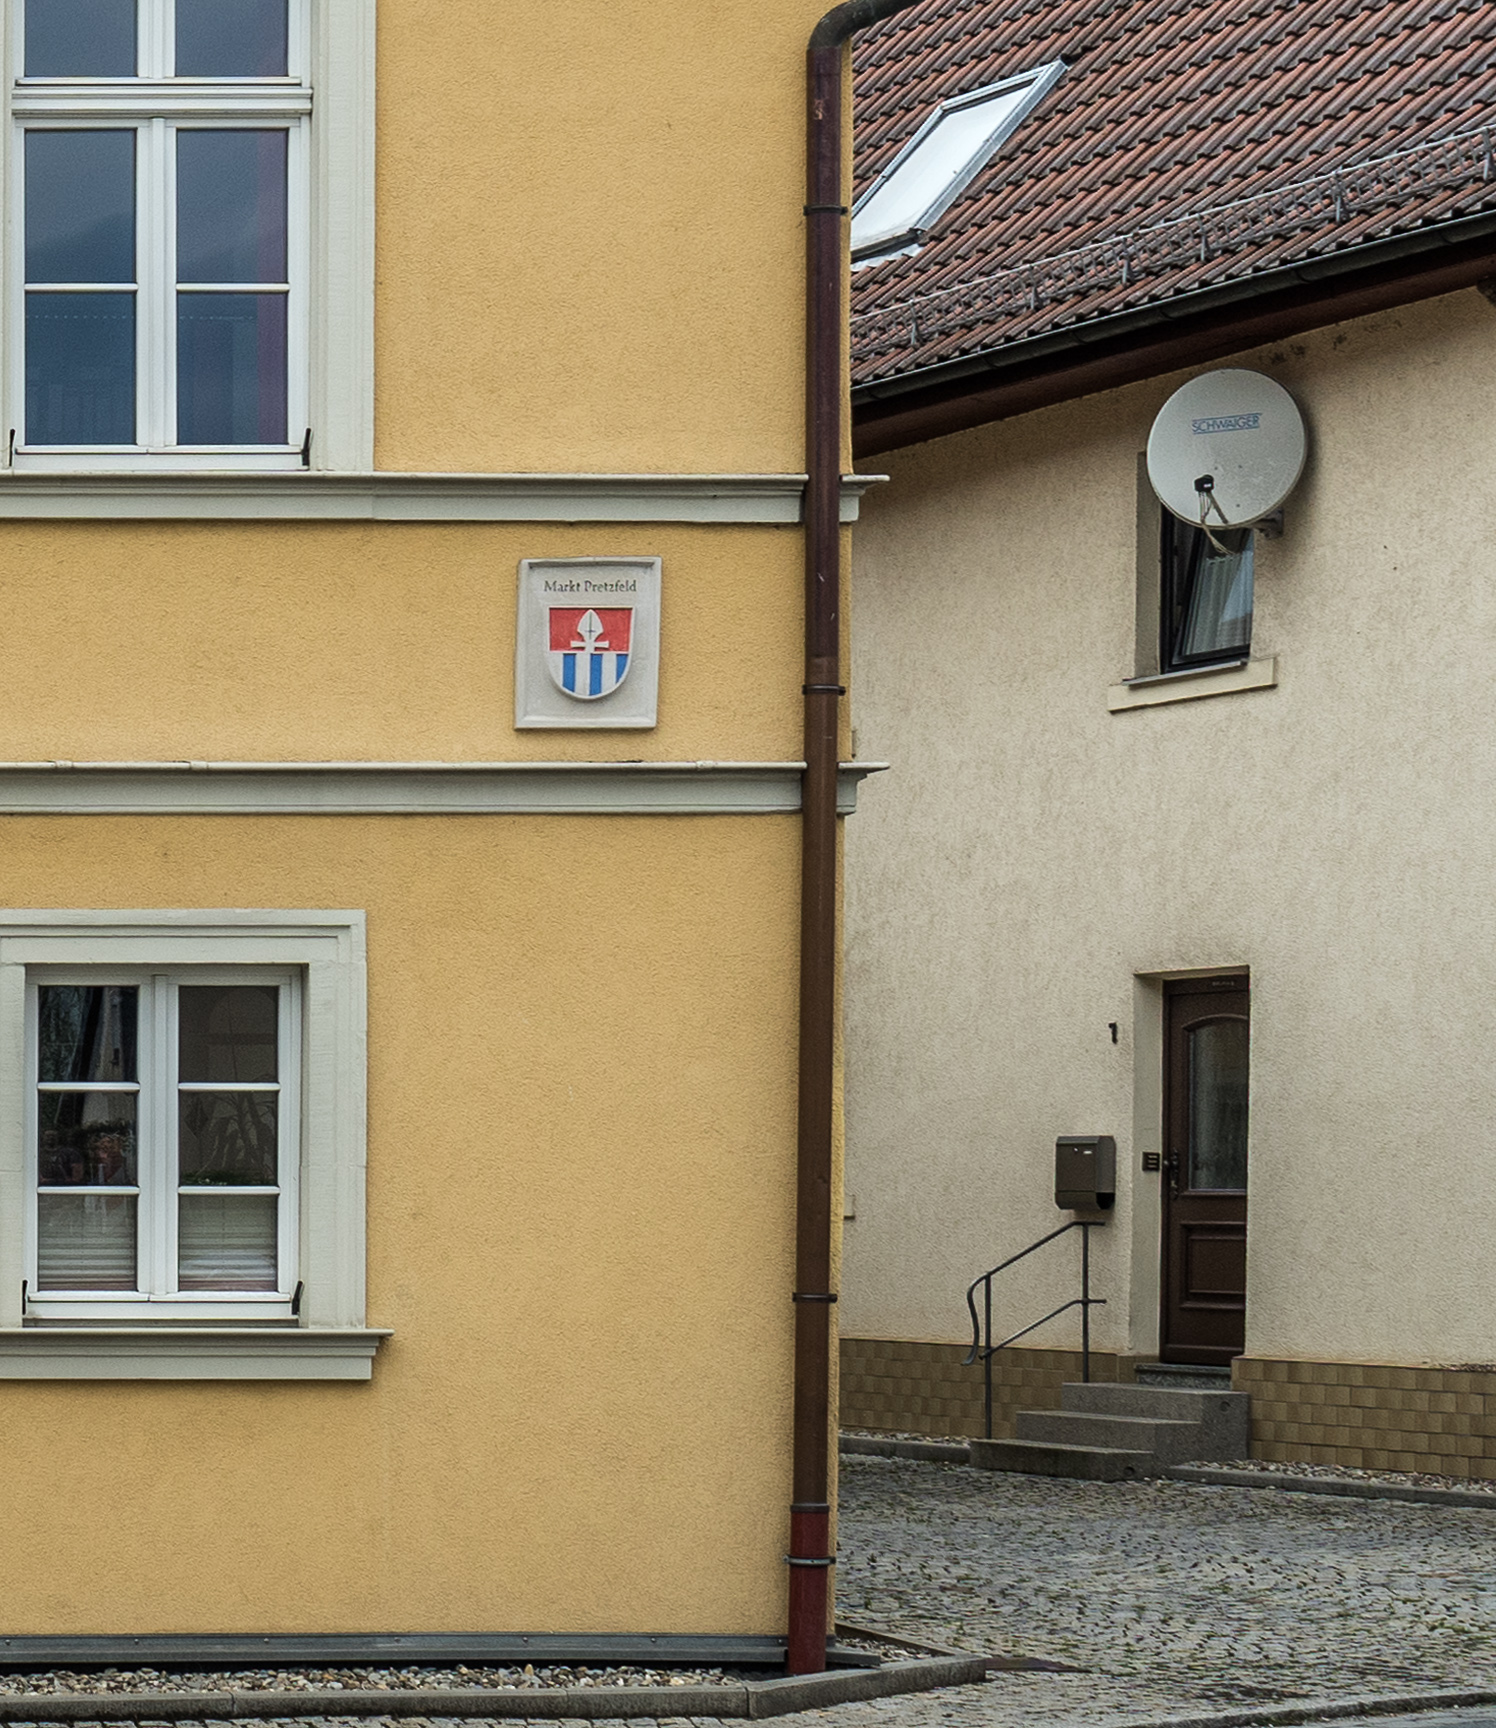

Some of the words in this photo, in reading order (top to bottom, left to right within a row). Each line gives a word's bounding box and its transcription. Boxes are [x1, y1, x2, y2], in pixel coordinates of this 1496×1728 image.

[1192, 415, 1260, 433] SCHWAIGER
[544, 579, 581, 593] Markt
[584, 579, 637, 593] Pretzfeld
[1108, 1022, 1118, 1045] 1
